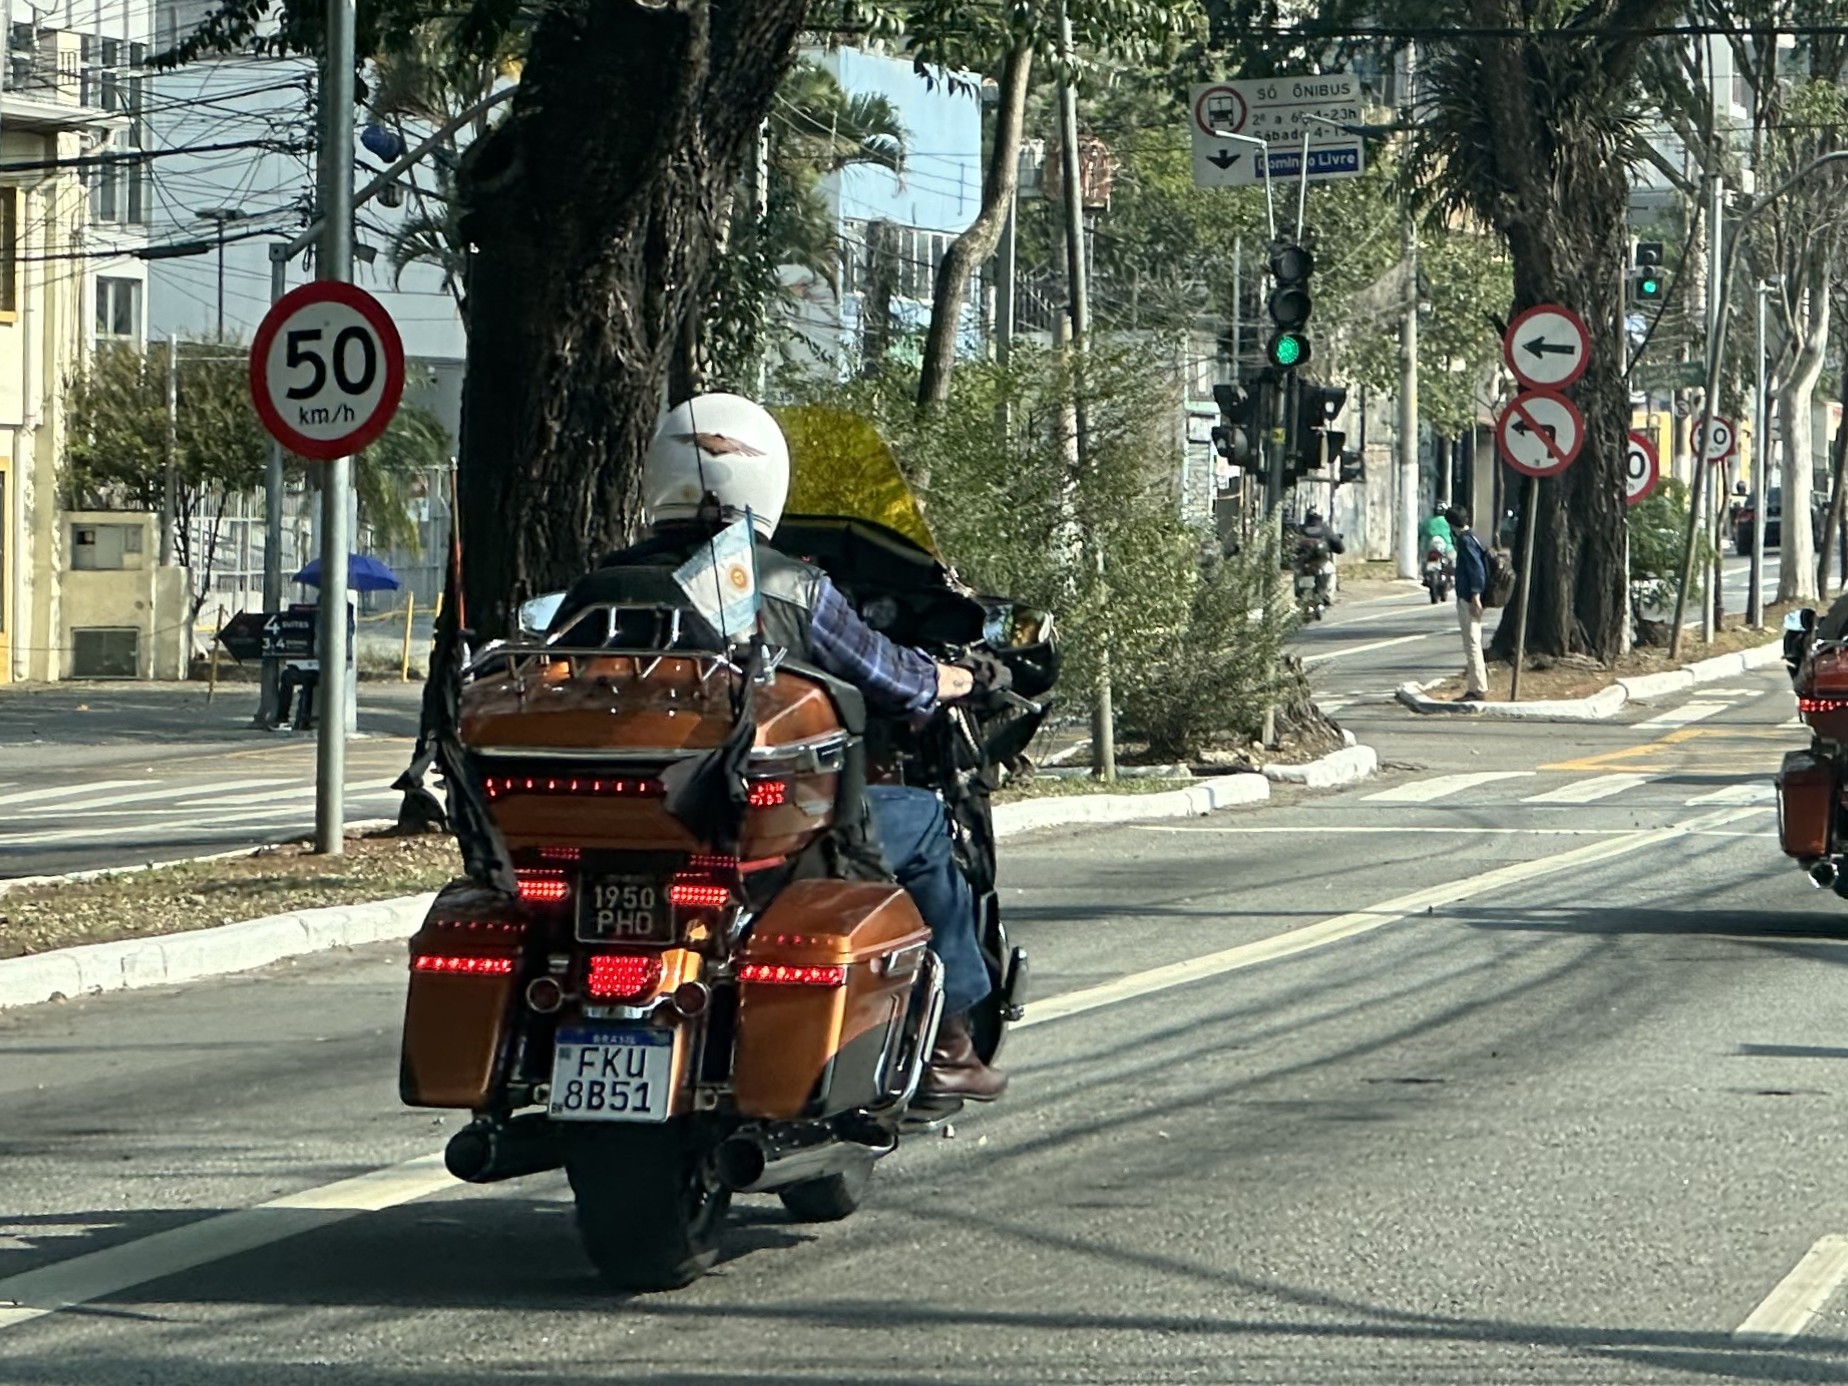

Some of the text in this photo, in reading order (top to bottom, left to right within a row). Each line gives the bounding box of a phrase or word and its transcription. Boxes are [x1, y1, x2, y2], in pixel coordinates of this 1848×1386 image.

[1257, 83, 1350, 100] SÓ ÔNIBUS
[1275, 115, 1282, 125] a
[1258, 152, 1356, 170] Domino Livre
[286, 326, 376, 400] 50
[299, 404, 355, 425] km/h
[264, 615, 280, 635] 4
[595, 886, 655, 909] 1950
[578, 1047, 646, 1078] FKU
[564, 1080, 651, 1112] 8B51
